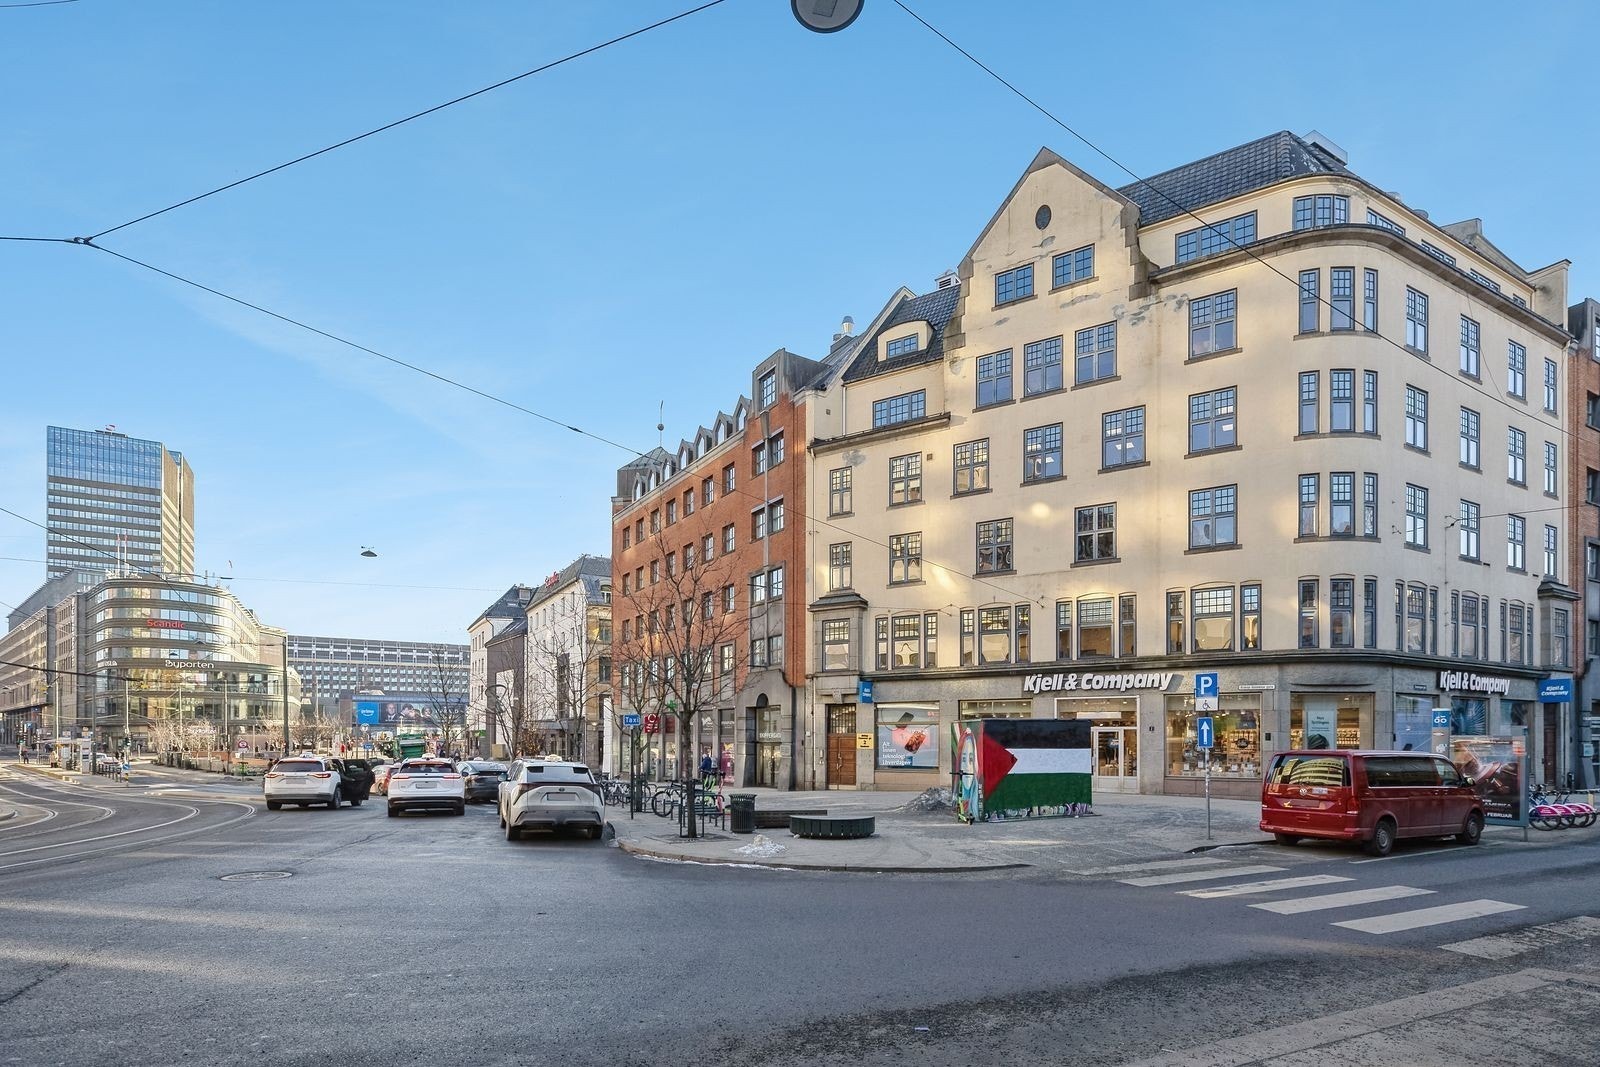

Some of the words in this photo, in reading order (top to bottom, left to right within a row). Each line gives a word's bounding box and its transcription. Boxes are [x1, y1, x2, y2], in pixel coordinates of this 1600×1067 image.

[147, 619, 186, 629] Scandic
[165, 659, 215, 669] Byporten
[1023, 673, 1064, 694] Kjell
[1064, 673, 1078, 691] &
[1081, 672, 1174, 692] Company
[1200, 676, 1213, 695] P
[1439, 670, 1462, 692] Kjell
[1462, 672, 1469, 690] &
[1469, 673, 1510, 695] Company
